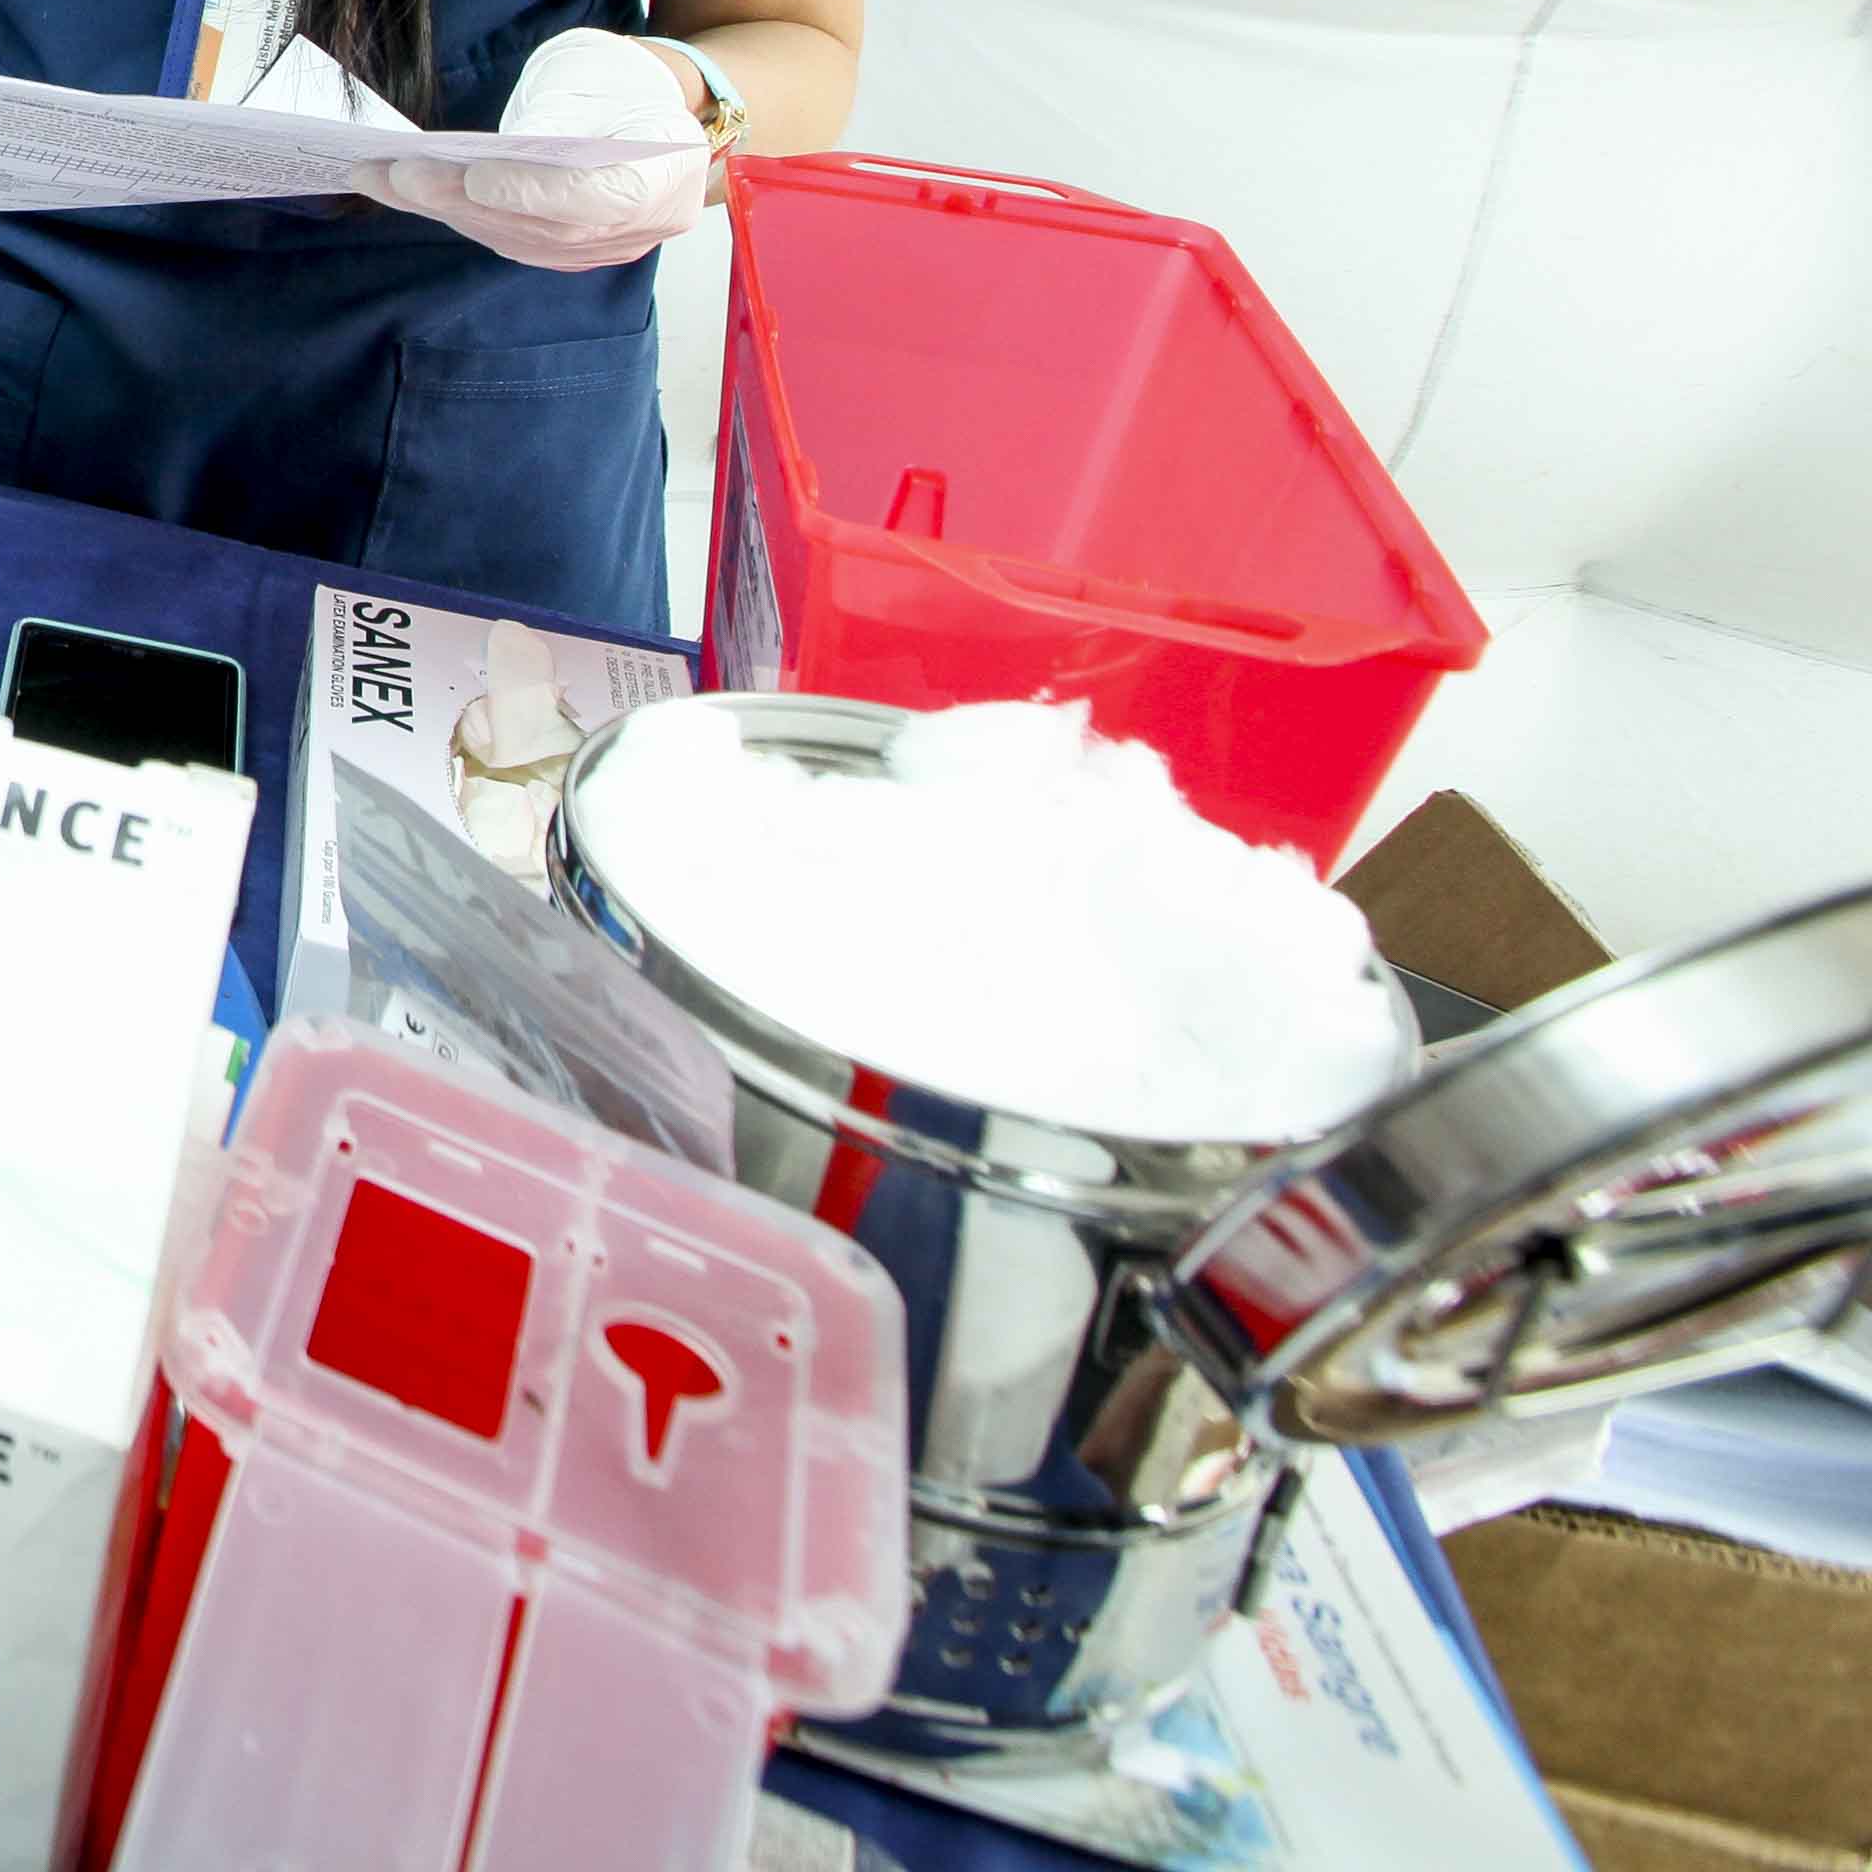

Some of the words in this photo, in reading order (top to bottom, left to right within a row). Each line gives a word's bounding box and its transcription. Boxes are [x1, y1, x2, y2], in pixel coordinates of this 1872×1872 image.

[333, 593, 347, 619] LATEX
[330, 619, 346, 675] EXAMINATION
[352, 601, 414, 733] SANEX
[330, 674, 345, 709] GLOVES
